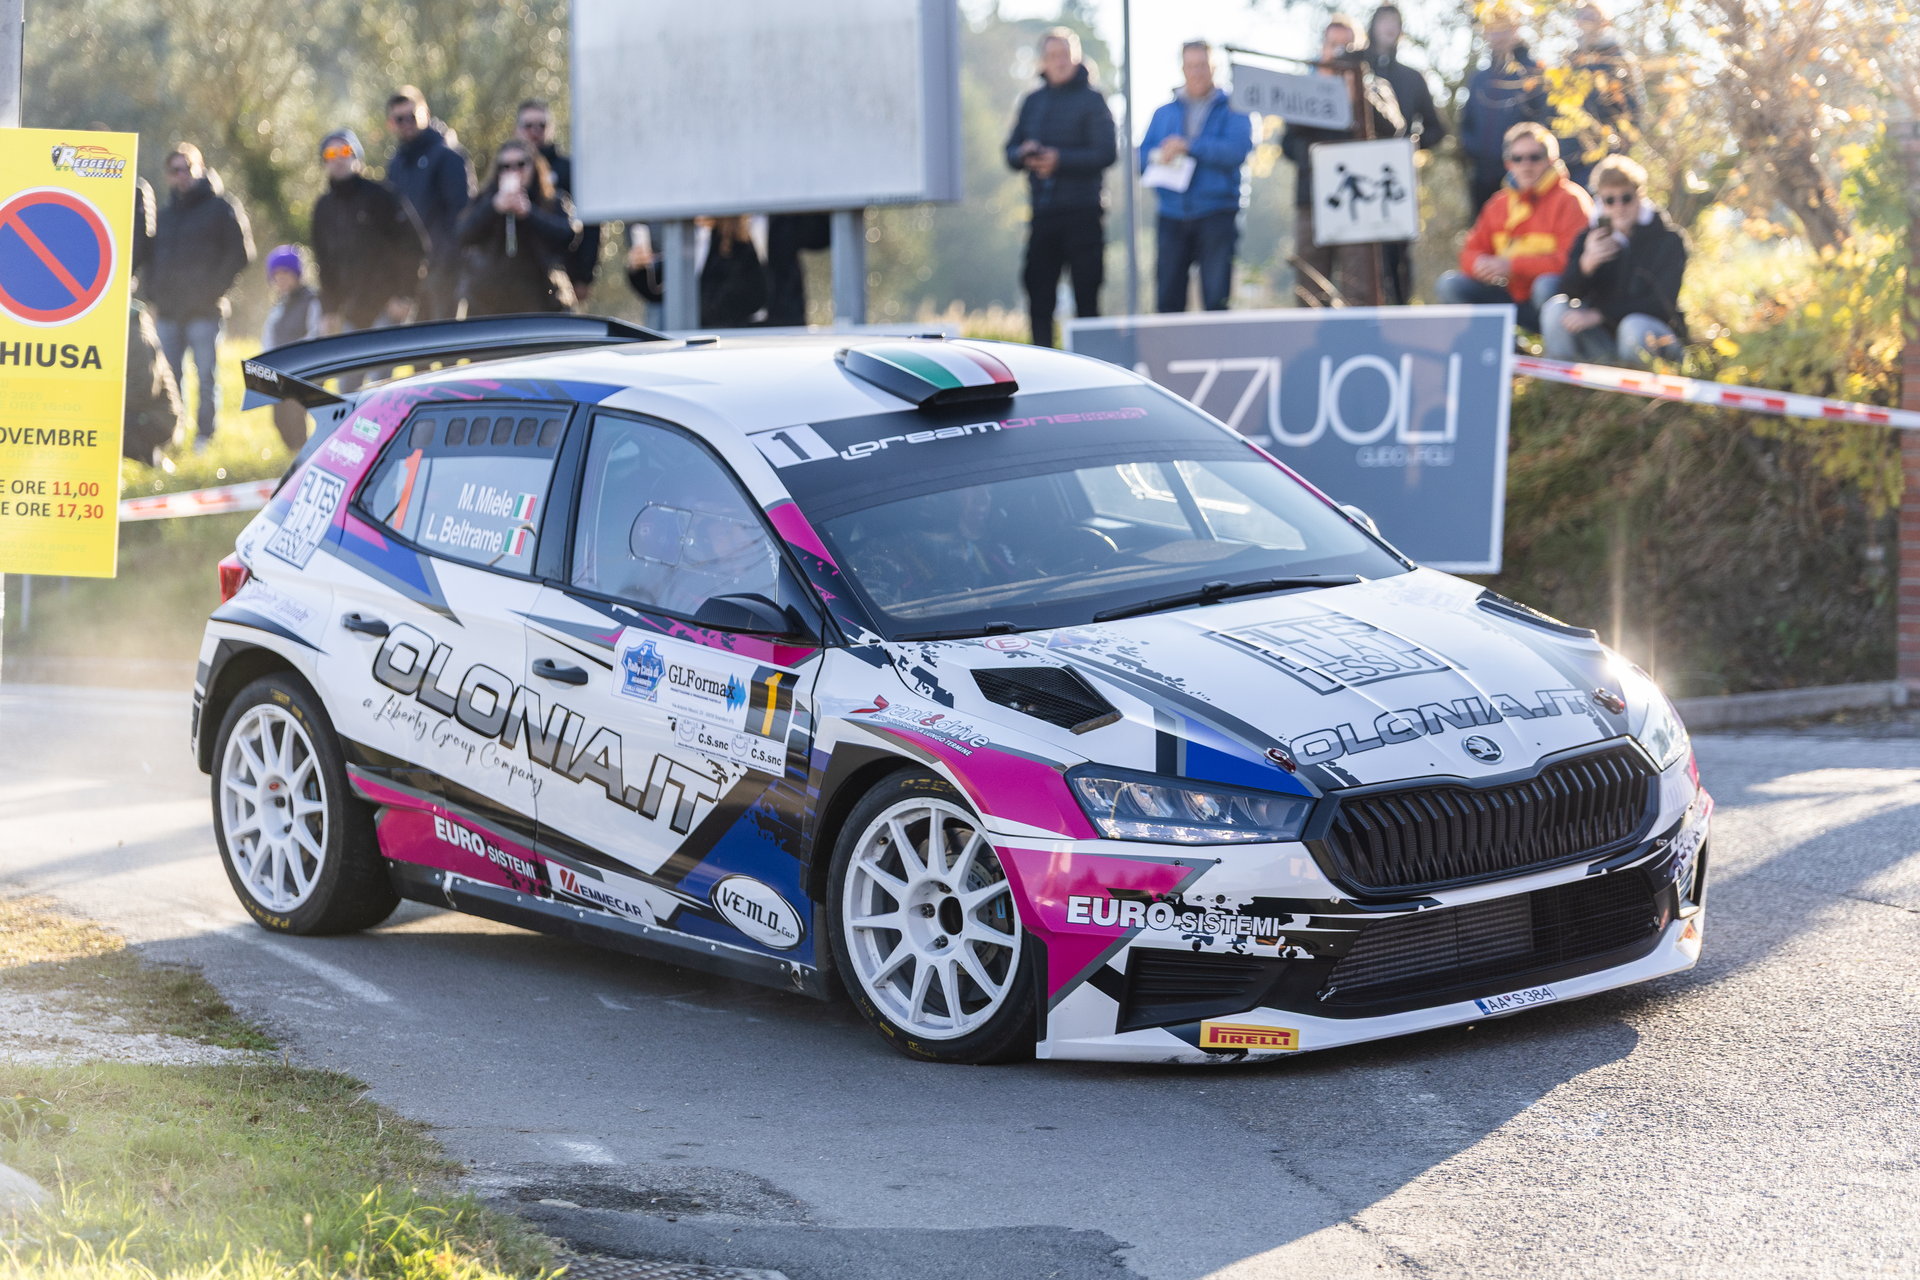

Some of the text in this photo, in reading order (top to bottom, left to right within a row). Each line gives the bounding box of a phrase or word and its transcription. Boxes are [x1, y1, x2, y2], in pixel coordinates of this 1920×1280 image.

[56, 146, 127, 174] REGGELLO
[1133, 353, 1462, 446] ZZUOLI
[771, 431, 812, 461] 1
[11, 480, 46, 495] ORE
[52, 481, 99, 498] 11,00
[393, 449, 423, 530] 1
[458, 483, 513, 517] M. Miele
[16, 502, 51, 517] ORE
[57, 503, 104, 520] 17,30
[425, 513, 503, 552] L. Beltrame
[668, 664, 735, 700] GLFormax
[1297, 648, 1439, 684] TESSUT
[761, 672, 783, 736] 1
[362, 693, 543, 797] a Liberty Group Company
[372, 622, 722, 835] OLONIA.IT
[698, 733, 729, 751] C.S.snc
[1290, 688, 1587, 766] OLONIA.IT
[751, 748, 782, 766] C.S.snc
[944, 738, 974, 757] TERMINE
[434, 815, 537, 880] EURO SISTEMI
[580, 885, 643, 917] EMMECAR
[1066, 894, 1280, 937] EURO SISTEMI
[1209, 1026, 1291, 1046] PIRELLI
